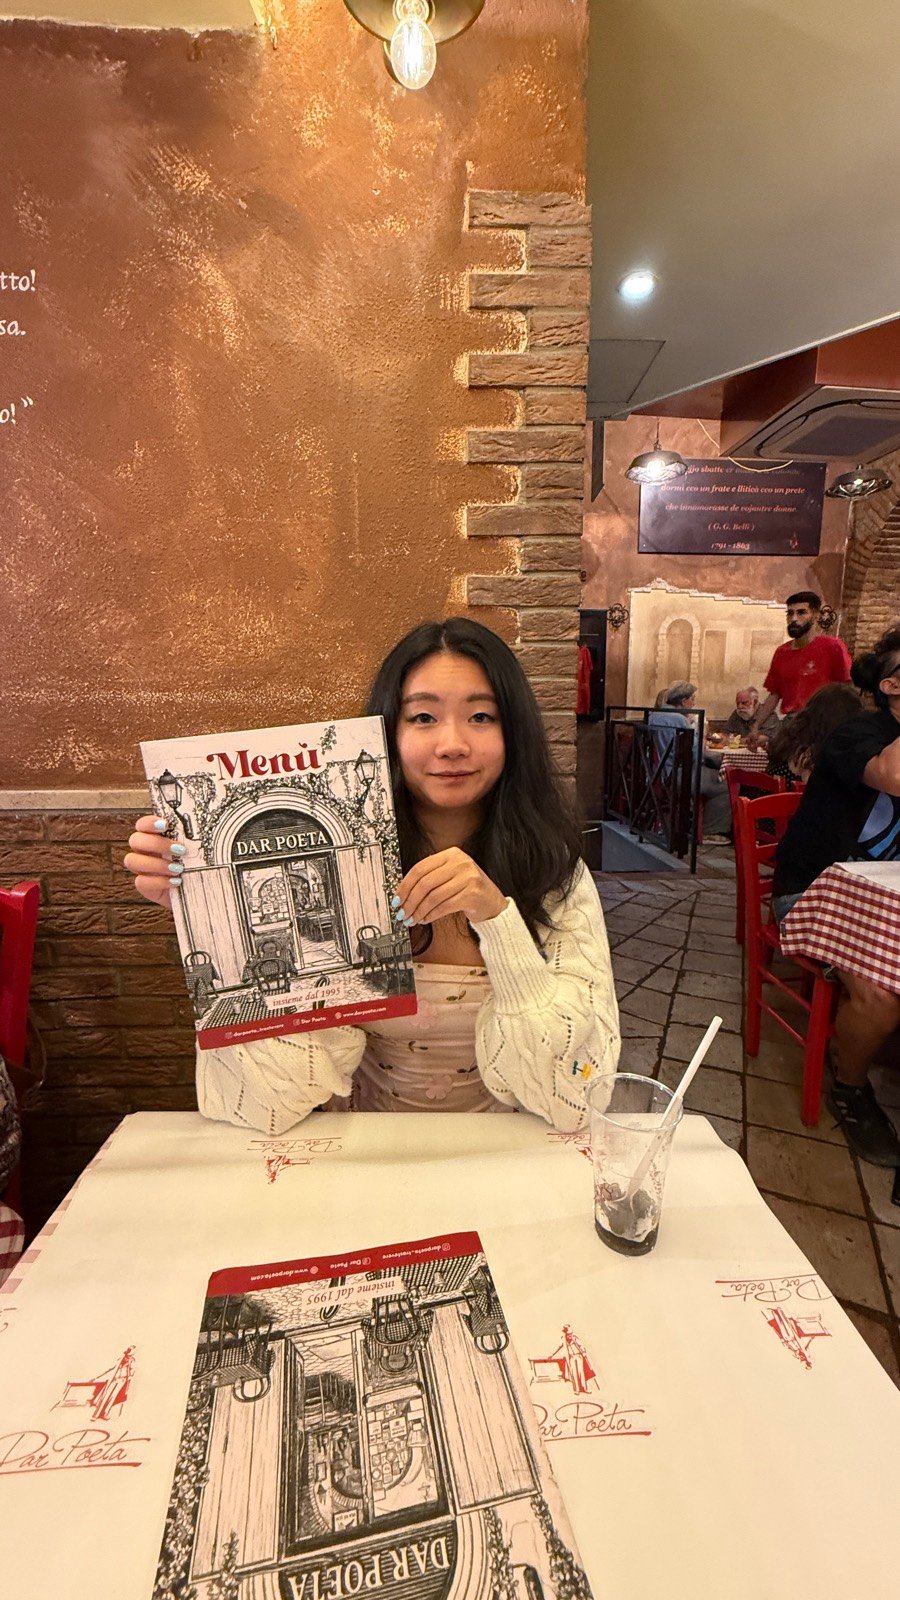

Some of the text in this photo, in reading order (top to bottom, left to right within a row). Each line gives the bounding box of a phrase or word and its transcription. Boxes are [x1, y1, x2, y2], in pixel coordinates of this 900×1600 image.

[710, 484, 731, 494] frate
[784, 487, 806, 495] prete
[206, 742, 321, 780] Menù
[236, 831, 328, 856] DAR POETA
[272, 987, 341, 1007] insieme dal 1995
[329, 1259, 362, 1269] Dar Poeta
[382, 1244, 442, 1259] darpoeta_trastevere
[250, 1268, 309, 1281] www.darpoeta.com
[307, 1280, 395, 1305] insieme dal 1995
[554, 1402, 645, 1435] Poeta
[52, 1429, 151, 1465] Poeta
[288, 1536, 451, 1600] DAR POETA
